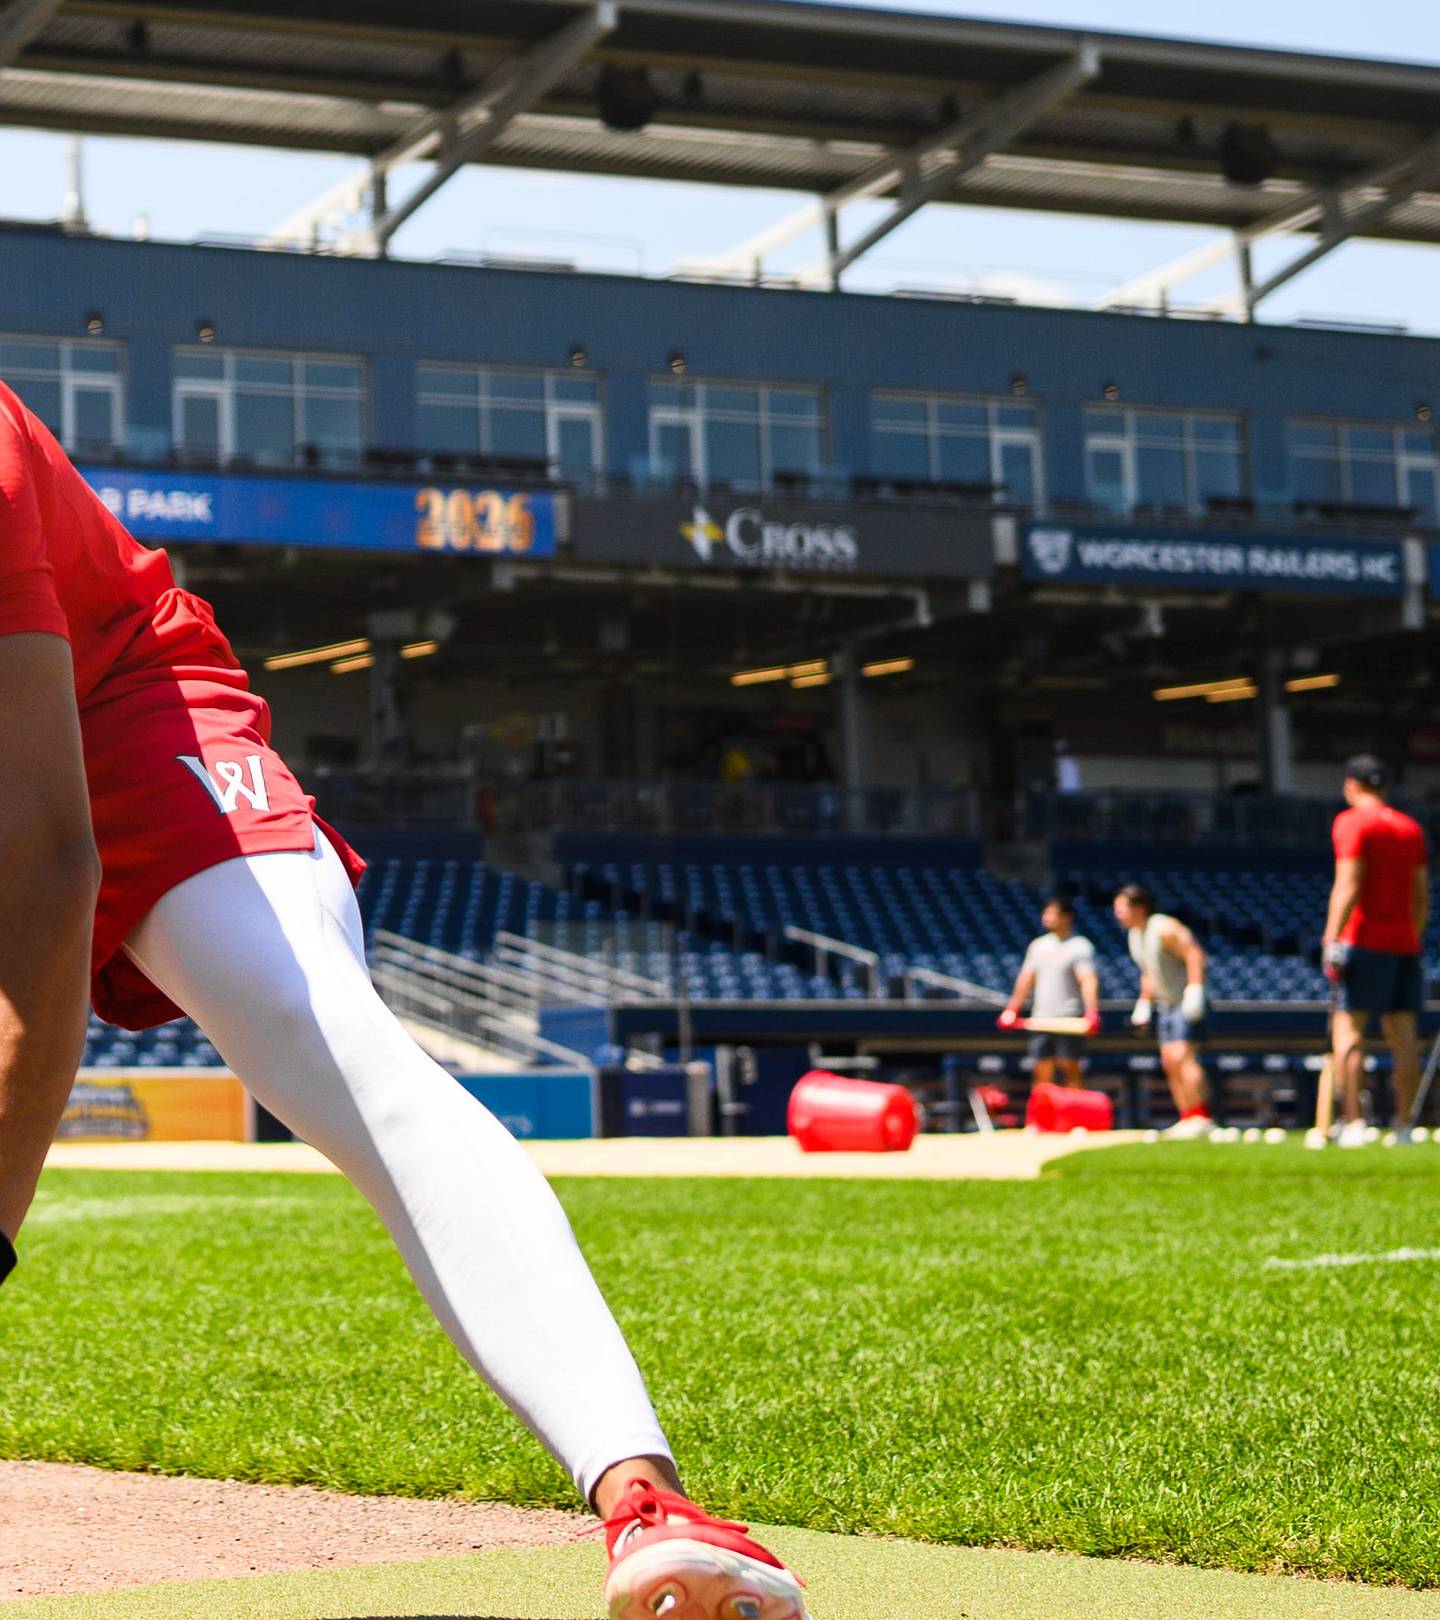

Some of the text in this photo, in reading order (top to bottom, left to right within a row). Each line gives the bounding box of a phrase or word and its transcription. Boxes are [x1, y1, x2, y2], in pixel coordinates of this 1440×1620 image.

[127, 488, 214, 523] PARK
[416, 488, 534, 552] 2026
[1076, 540, 1400, 582] WORCESTER RAILERS HC
[175, 754, 271, 814] W
